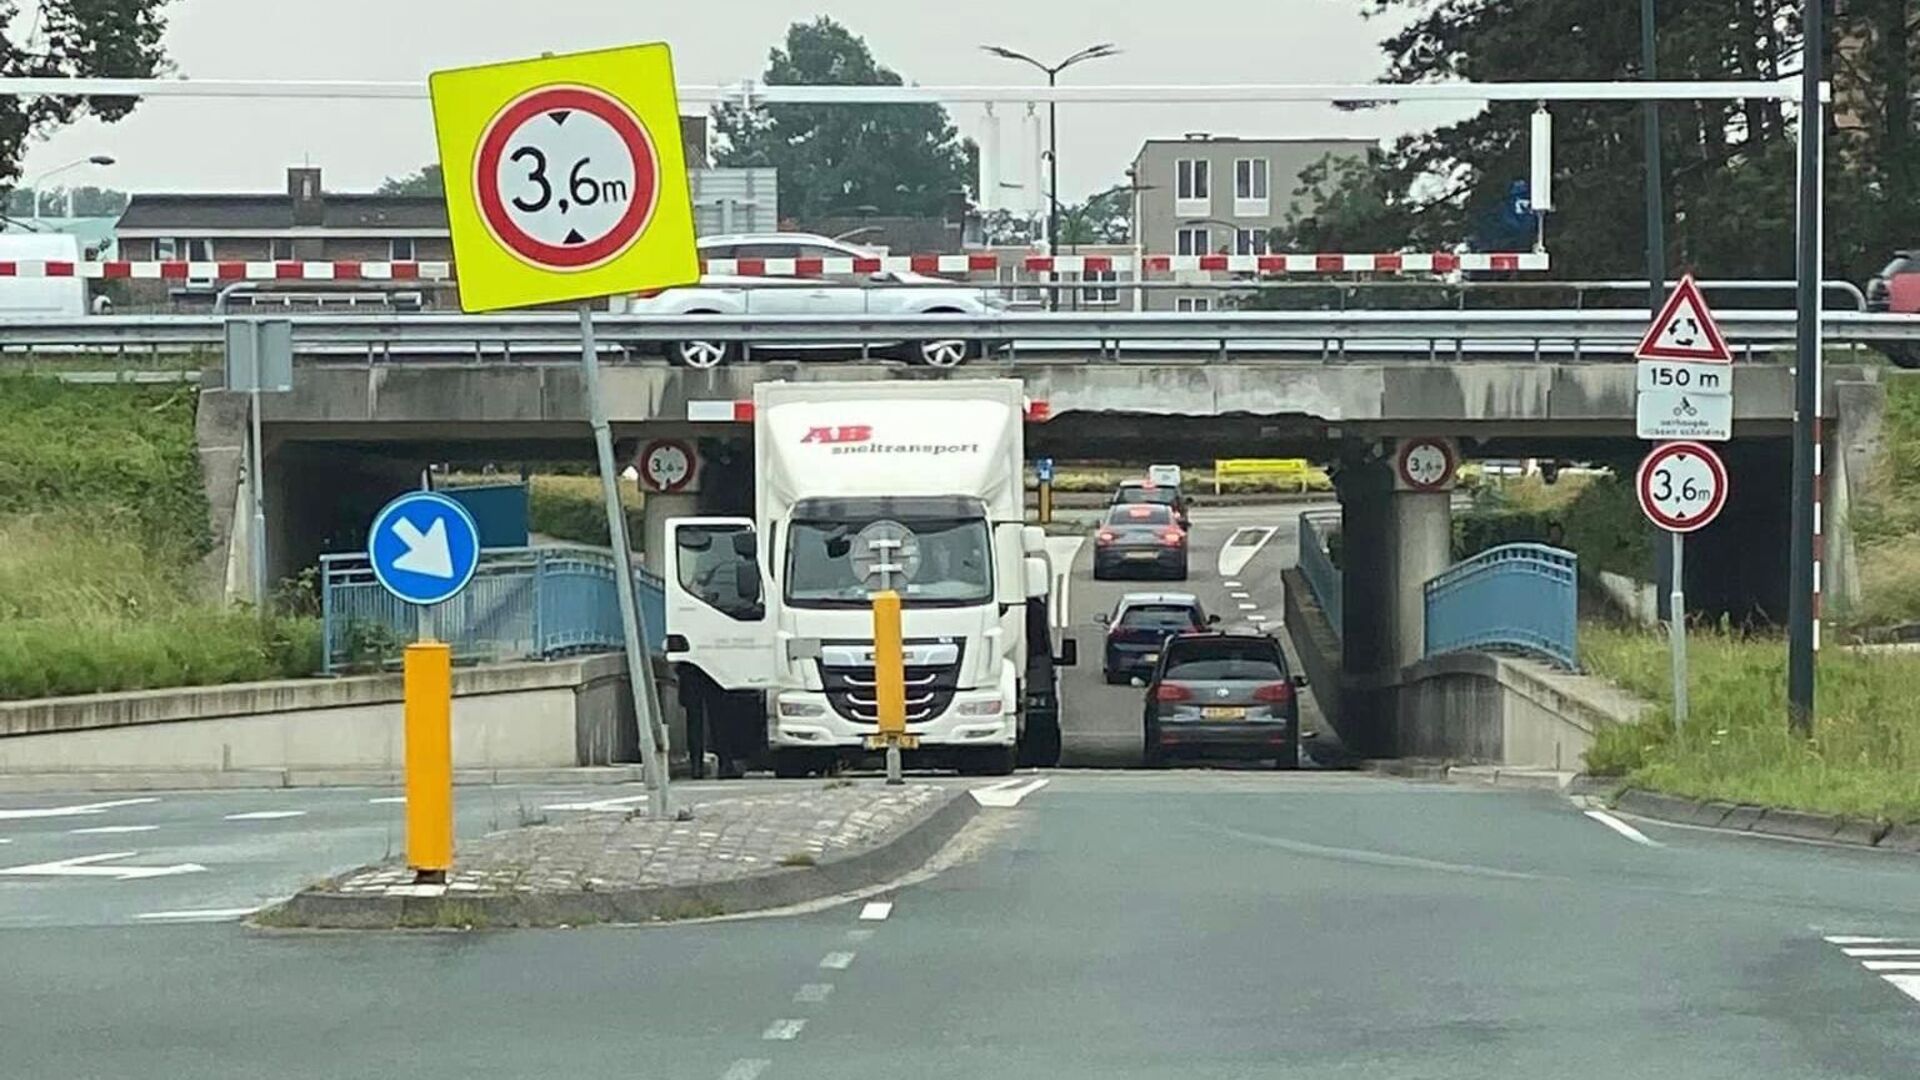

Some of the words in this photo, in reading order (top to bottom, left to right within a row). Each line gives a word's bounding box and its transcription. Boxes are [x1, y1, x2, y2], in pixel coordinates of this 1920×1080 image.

[511, 146, 627, 215] 3,6m
[1651, 368, 1691, 387] 150
[1700, 372, 1720, 388] m
[800, 425, 874, 444] AB
[831, 443, 980, 456] sneltransport
[1653, 470, 1711, 503] 3,6m
